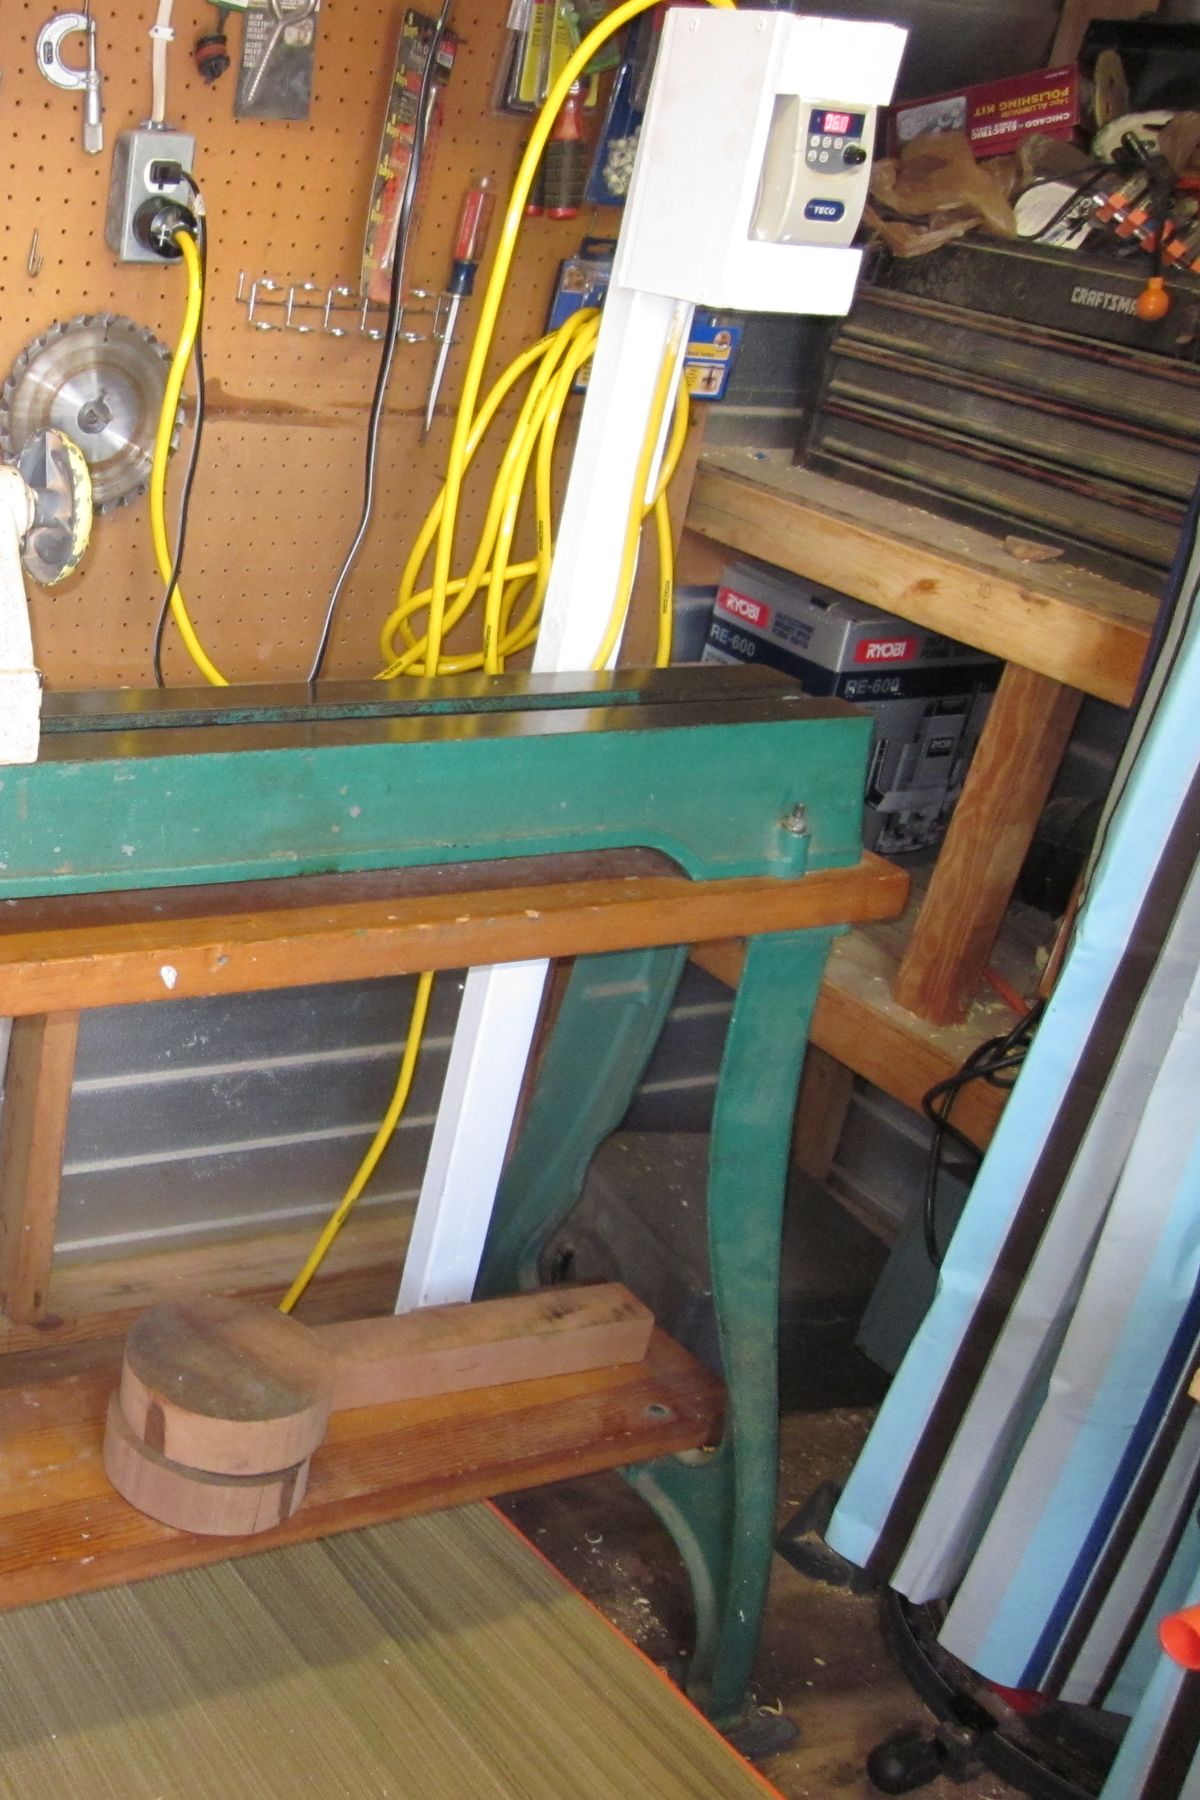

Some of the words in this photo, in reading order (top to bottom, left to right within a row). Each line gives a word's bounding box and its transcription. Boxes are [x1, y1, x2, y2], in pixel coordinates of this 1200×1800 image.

[999, 87, 1070, 111] POLISHING
[974, 105, 996, 118] KIT
[1025, 112, 1071, 128] CHICAGO
[970, 122, 1017, 140] ELECTRIC
[814, 205, 836, 216] TECO
[726, 593, 761, 622] RYOBI
[709, 623, 756, 657] RE-600
[865, 642, 908, 659] RYOBI
[844, 678, 899, 695] RE-600
